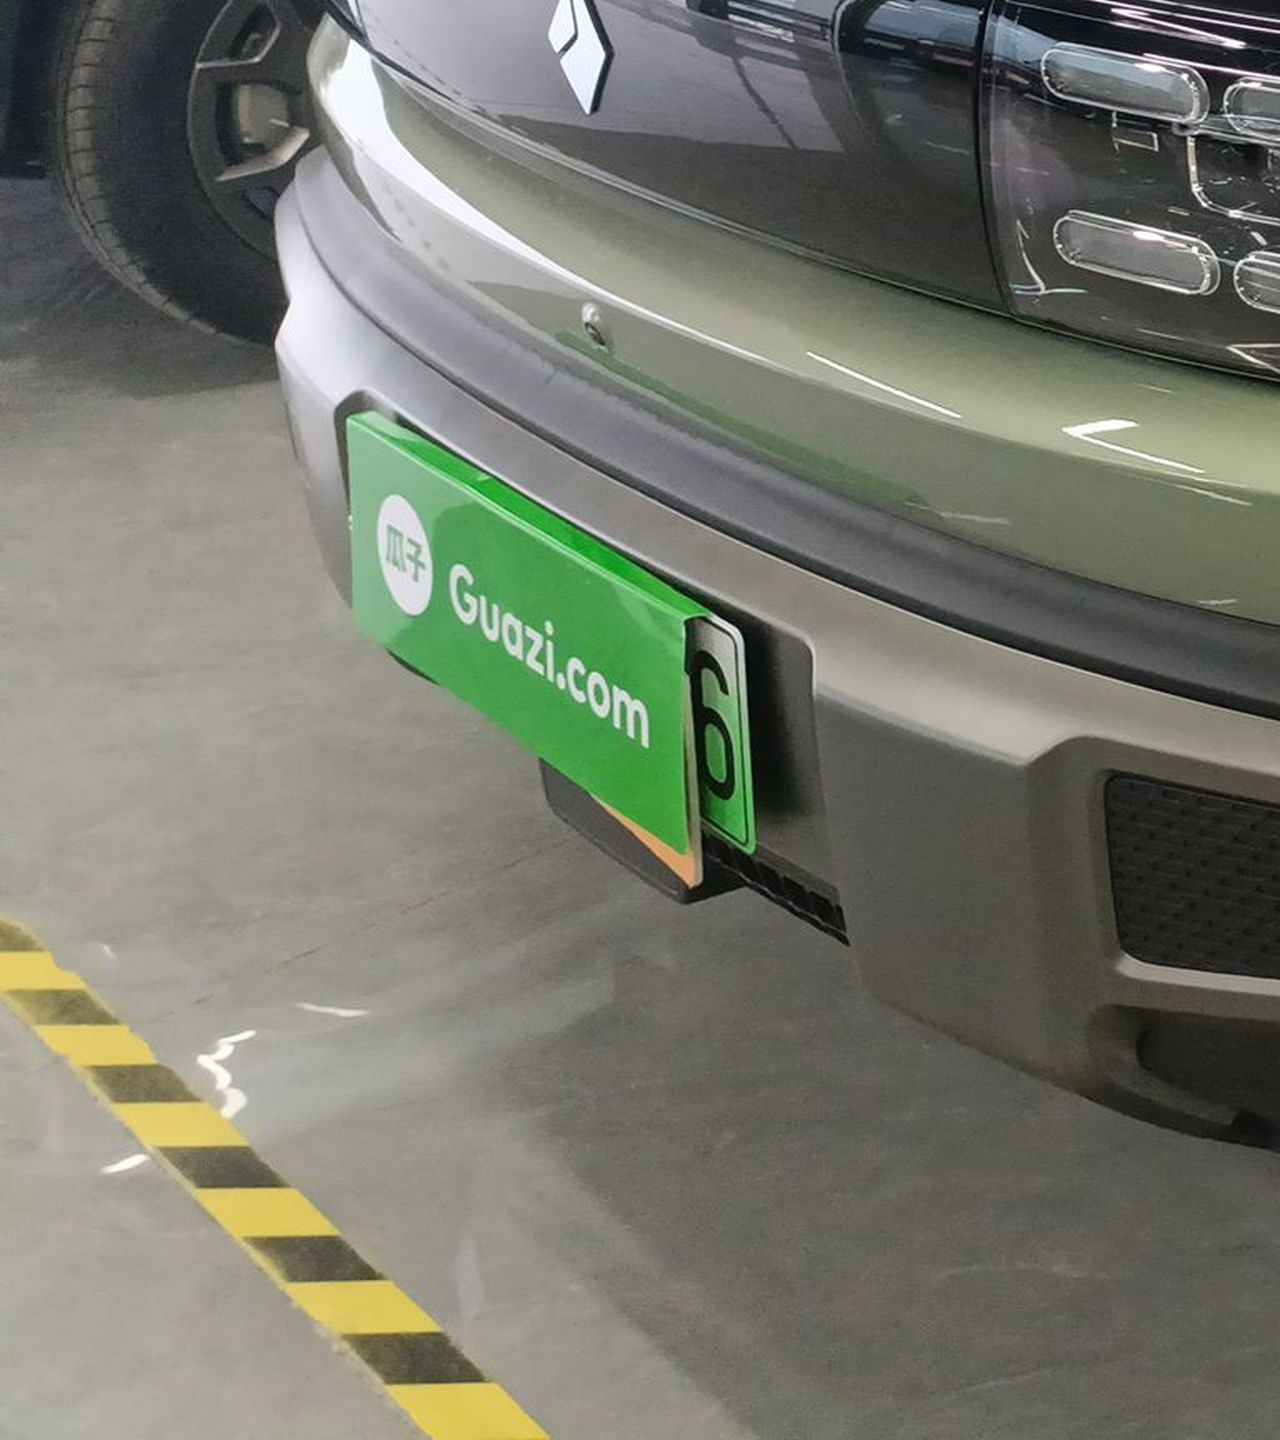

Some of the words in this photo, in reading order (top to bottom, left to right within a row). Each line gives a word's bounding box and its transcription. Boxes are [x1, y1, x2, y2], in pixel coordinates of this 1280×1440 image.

[385, 523, 427, 584] 瓜子
[449, 563, 650, 749] Guazi.com
[691, 649, 736, 800] 6
